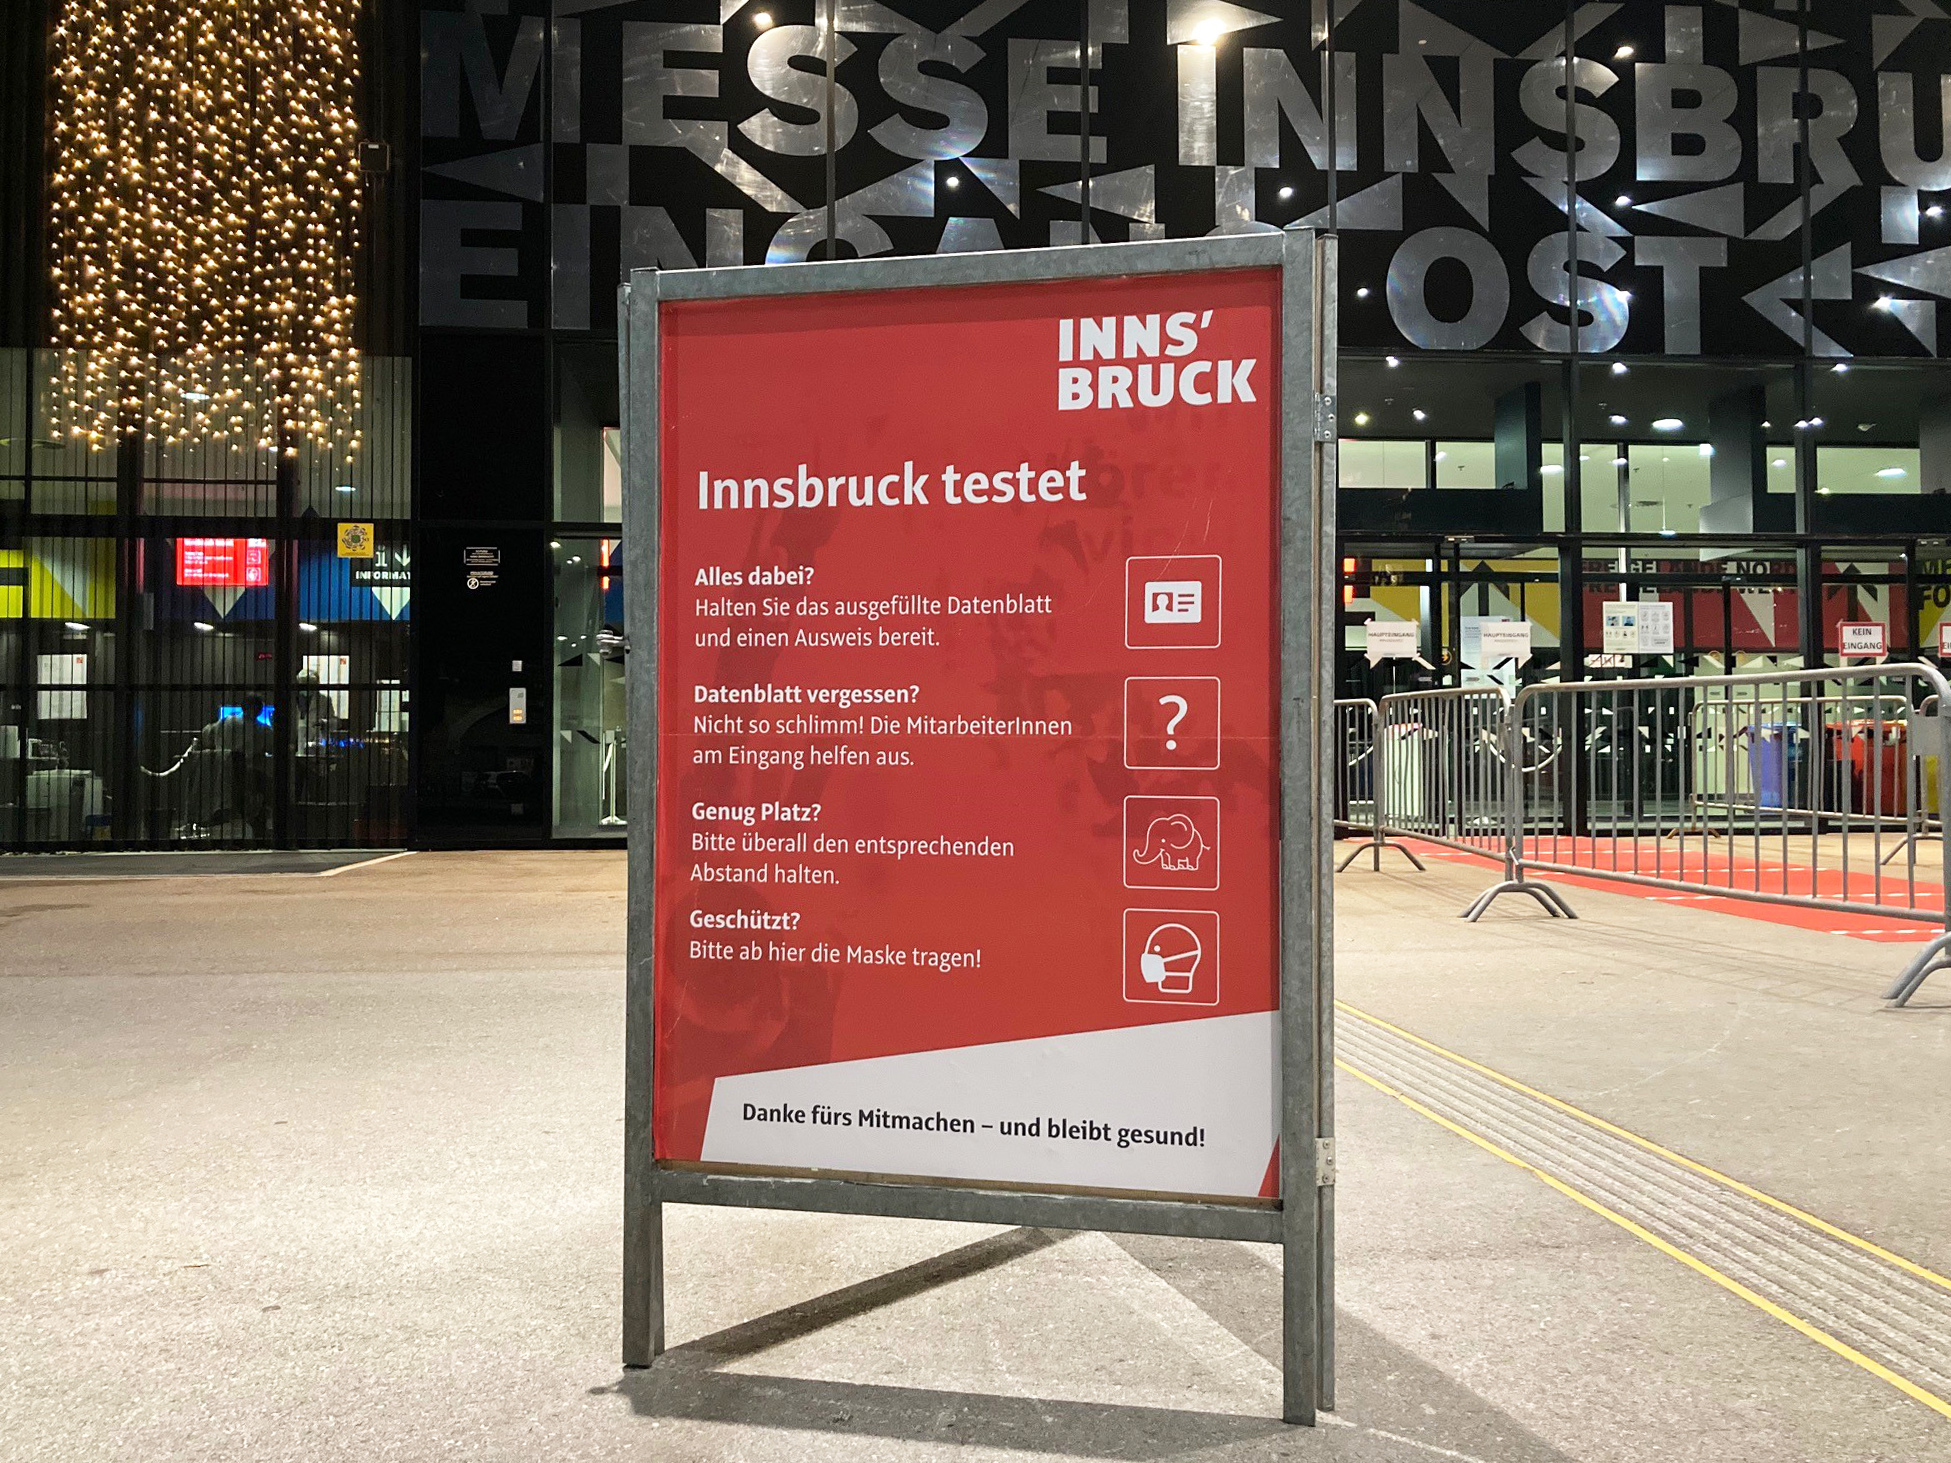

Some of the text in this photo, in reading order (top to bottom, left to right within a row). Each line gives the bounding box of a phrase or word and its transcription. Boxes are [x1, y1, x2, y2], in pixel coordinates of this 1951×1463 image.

[420, 15, 1107, 164] MESSE
[1386, 226, 1728, 355] OST
[1057, 358, 1258, 411] BRUCK
[698, 460, 930, 510] Innsbruck
[940, 459, 1088, 505] testet
[694, 565, 815, 586] Alles dabei?
[695, 592, 1053, 621] Halten Sie das ausgefüllte Datenblatt
[695, 625, 940, 648] und einen Ausweis bereit.
[1843, 641, 1882, 650] EINGANG
[694, 683, 920, 709] Datenblatt vergessen?
[693, 713, 1072, 736] Nicht so schlimm! Die MitarbeiterInnen
[692, 744, 915, 771] am Eingang helfen aus.
[691, 800, 822, 827] Genug Platz?
[691, 831, 1014, 861] Bitte überall den entsprechenden
[689, 861, 840, 885] Abstand halten.
[689, 908, 801, 931] Geschützt?
[689, 939, 981, 973] Bitte ab hier die Maske tragen!
[743, 1103, 806, 1124] Danke
[811, 1104, 852, 1127] fürs
[858, 1108, 975, 1134] Mitmachen
[1000, 1116, 1041, 1138] und
[1047, 1117, 1112, 1142] bleibt
[1116, 1126, 1205, 1149] gesund!
